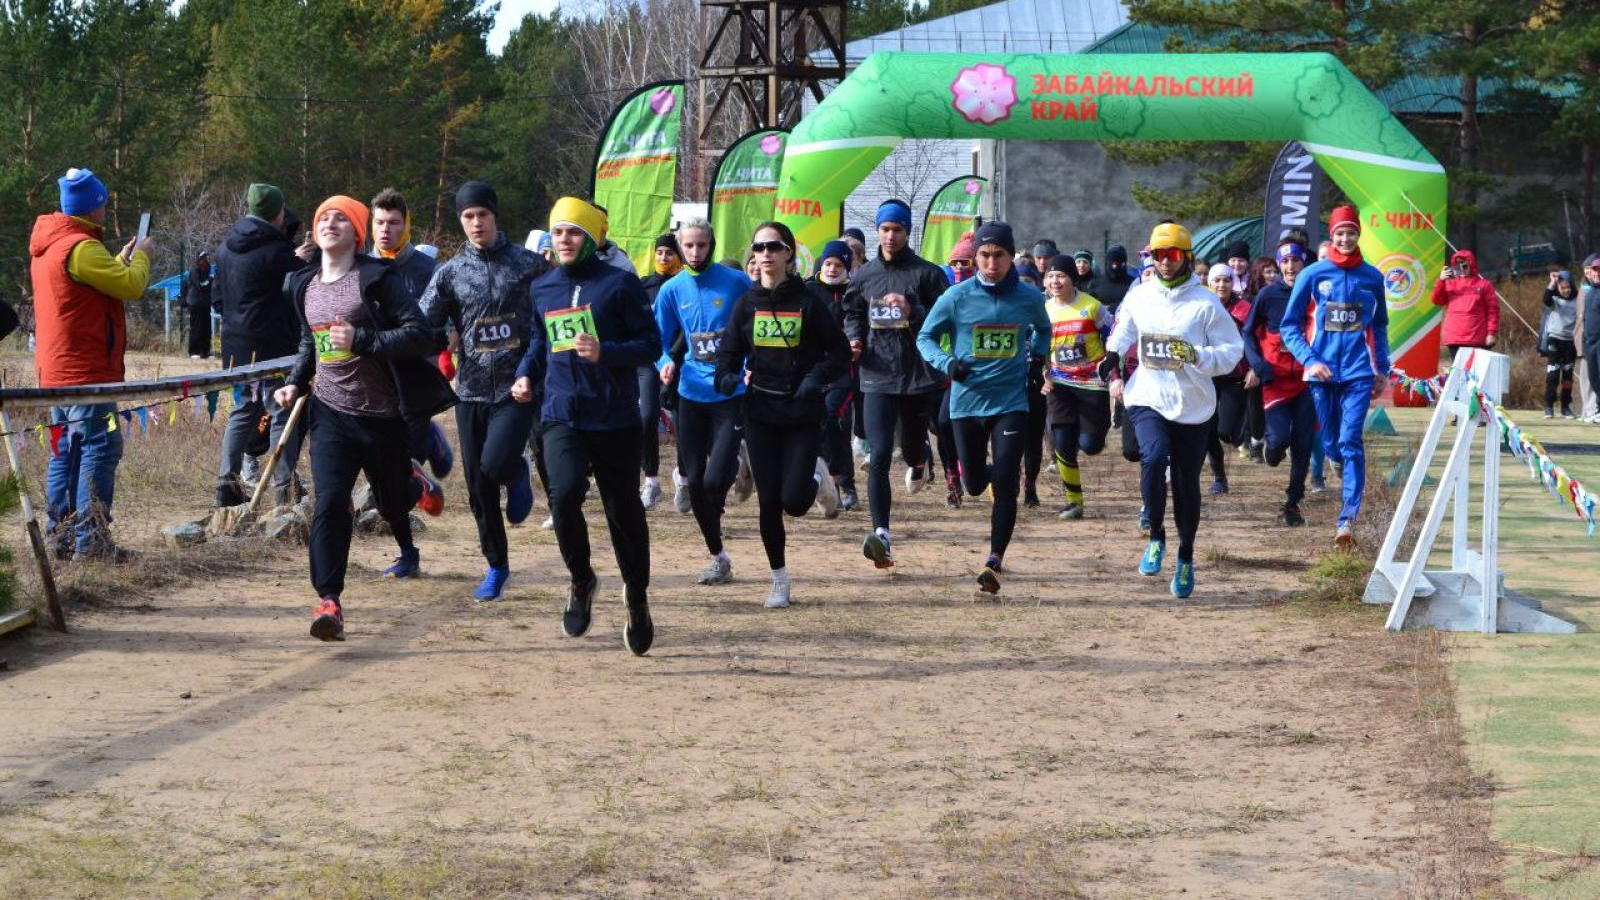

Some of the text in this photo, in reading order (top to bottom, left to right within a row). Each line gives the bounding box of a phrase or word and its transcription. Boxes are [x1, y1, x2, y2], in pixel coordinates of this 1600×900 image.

[1031, 71, 1254, 98] ЗАБАЙКАЛЬСКИЙ
[1031, 97, 1098, 121] КРАЙ
[735, 167, 772, 181] ЧИТА
[1280, 154, 1314, 241] MIN
[774, 198, 823, 218] ЧИТА
[1386, 211, 1434, 231] ЧИТА
[871, 306, 901, 320] 126
[1330, 309, 1357, 323] 109
[478, 323, 512, 342] 110
[550, 316, 589, 342] 151
[756, 320, 797, 338] 322
[976, 332, 1016, 351] 153
[1059, 348, 1083, 361] 131
